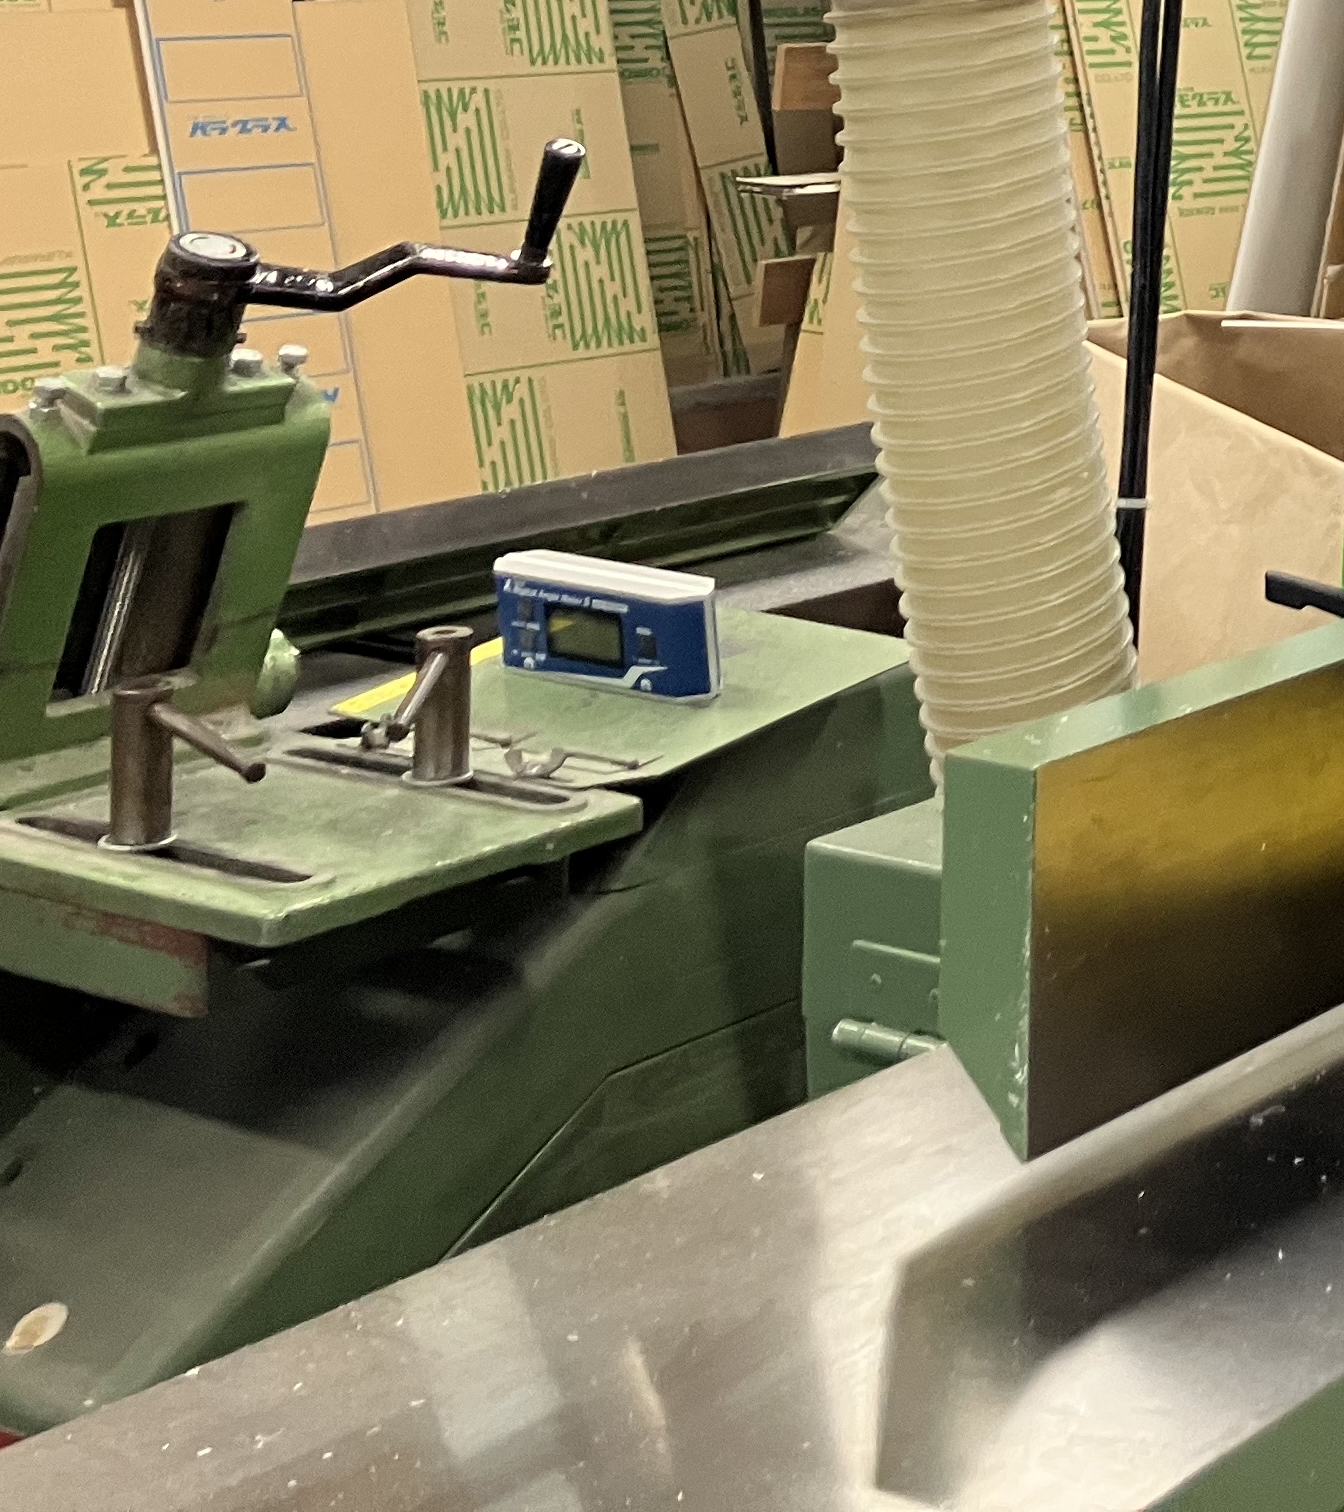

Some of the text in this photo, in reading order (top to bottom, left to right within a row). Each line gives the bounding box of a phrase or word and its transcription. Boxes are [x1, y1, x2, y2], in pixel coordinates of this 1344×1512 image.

[1178, 90, 1239, 109] モグラス
[188, 116, 296, 138] パラグラス
